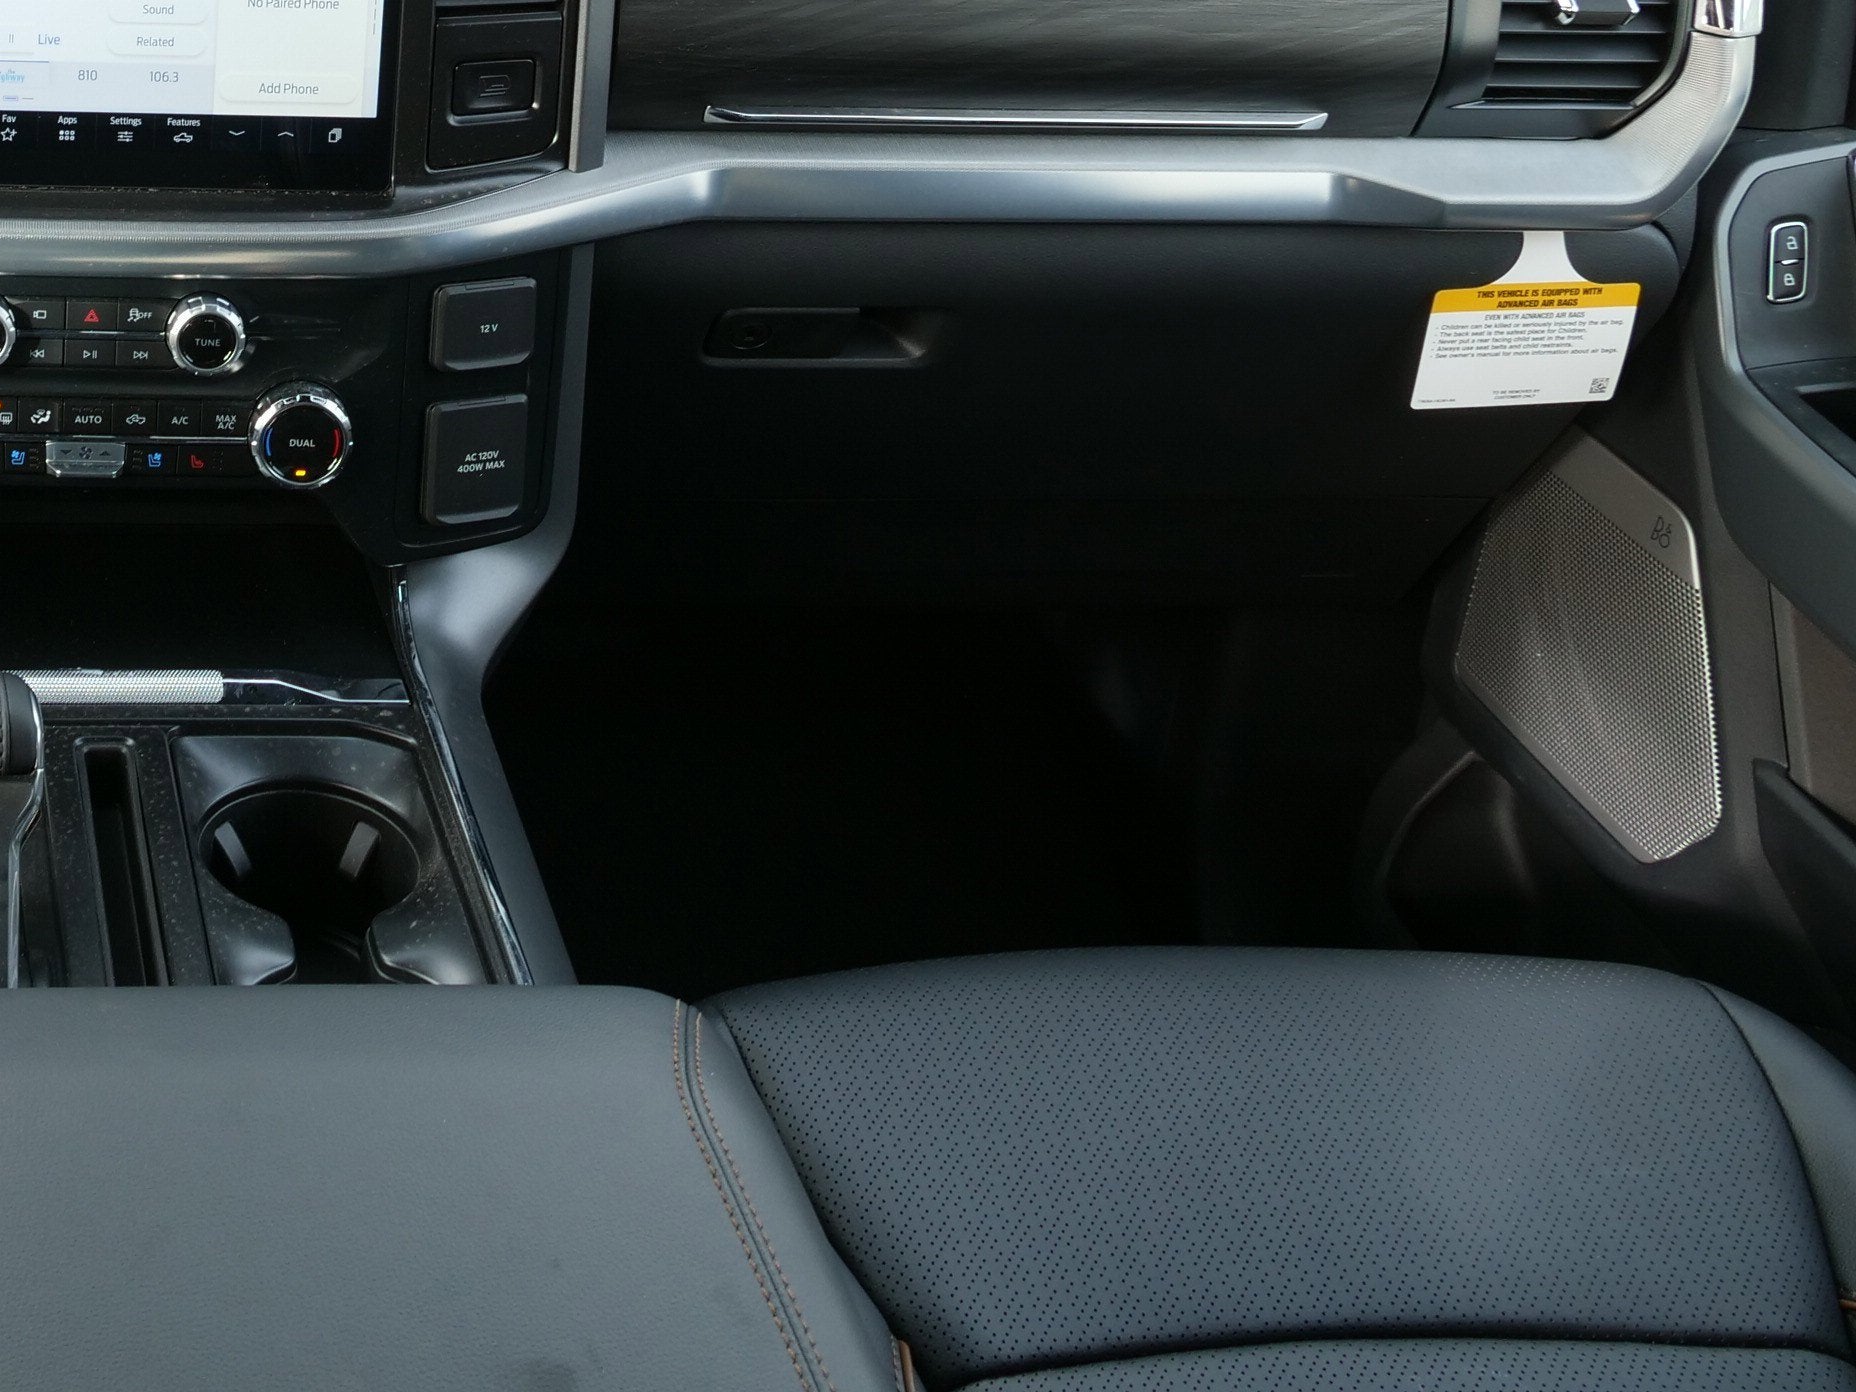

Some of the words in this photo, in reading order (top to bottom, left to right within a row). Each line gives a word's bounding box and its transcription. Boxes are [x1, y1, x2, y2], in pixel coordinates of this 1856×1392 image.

[142, 4, 174, 15] Sound
[38, 34, 61, 46] Live
[136, 36, 175, 47] Related
[78, 70, 98, 82] 810
[150, 71, 179, 84] 106.3
[258, 83, 281, 94] Add
[284, 84, 319, 95] Phone
[2, 114, 17, 123] Fav
[58, 116, 78, 125] Apps
[110, 116, 142, 126] Settings
[167, 118, 201, 127] Features
[1478, 290, 1495, 299] THIS
[1498, 290, 1529, 298] VEHICLE
[1532, 289, 1539, 297] IS
[1542, 288, 1580, 297] EQUIPPED
[1582, 288, 1603, 296] WITH
[1496, 300, 1539, 309] ADVANCED
[1557, 299, 1578, 307] BAGS
[1520, 312, 1554, 320] ADVANCED
[480, 324, 491, 333] 12
[491, 324, 499, 332] V
[194, 338, 221, 347] TUNE
[75, 415, 103, 425] AUTO
[171, 416, 189, 425] A/C
[216, 414, 237, 423] MAX
[216, 422, 236, 430] A/C
[289, 439, 315, 448] DUAL
[464, 453, 477, 462] AC
[478, 451, 500, 461] 120V
[456, 462, 484, 474] 400W
[486, 459, 506, 470] MAX
